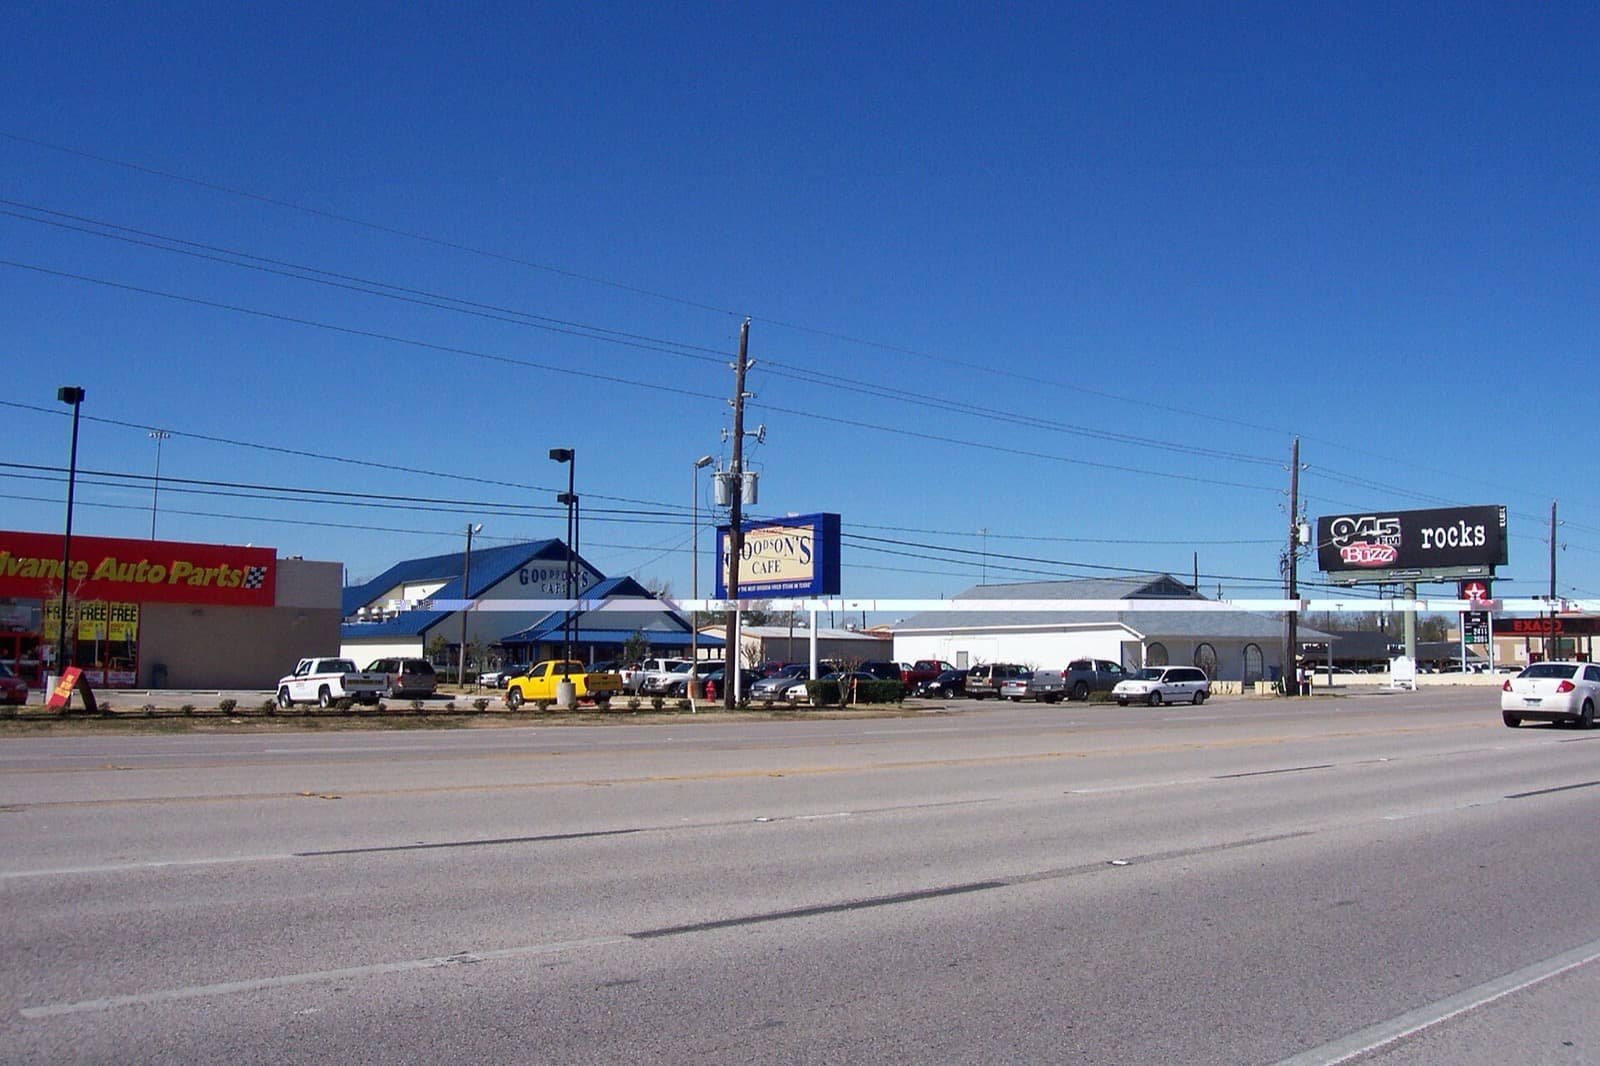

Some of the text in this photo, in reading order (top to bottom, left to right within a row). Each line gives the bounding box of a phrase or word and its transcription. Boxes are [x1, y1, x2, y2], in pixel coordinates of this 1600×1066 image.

[1421, 520, 1486, 549] rocks
[91, 557, 166, 583] Auto
[168, 560, 242, 588] Parts
[752, 560, 782, 575] CAFE
[80, 606, 106, 621] FREE
[110, 607, 137, 622] FREE
